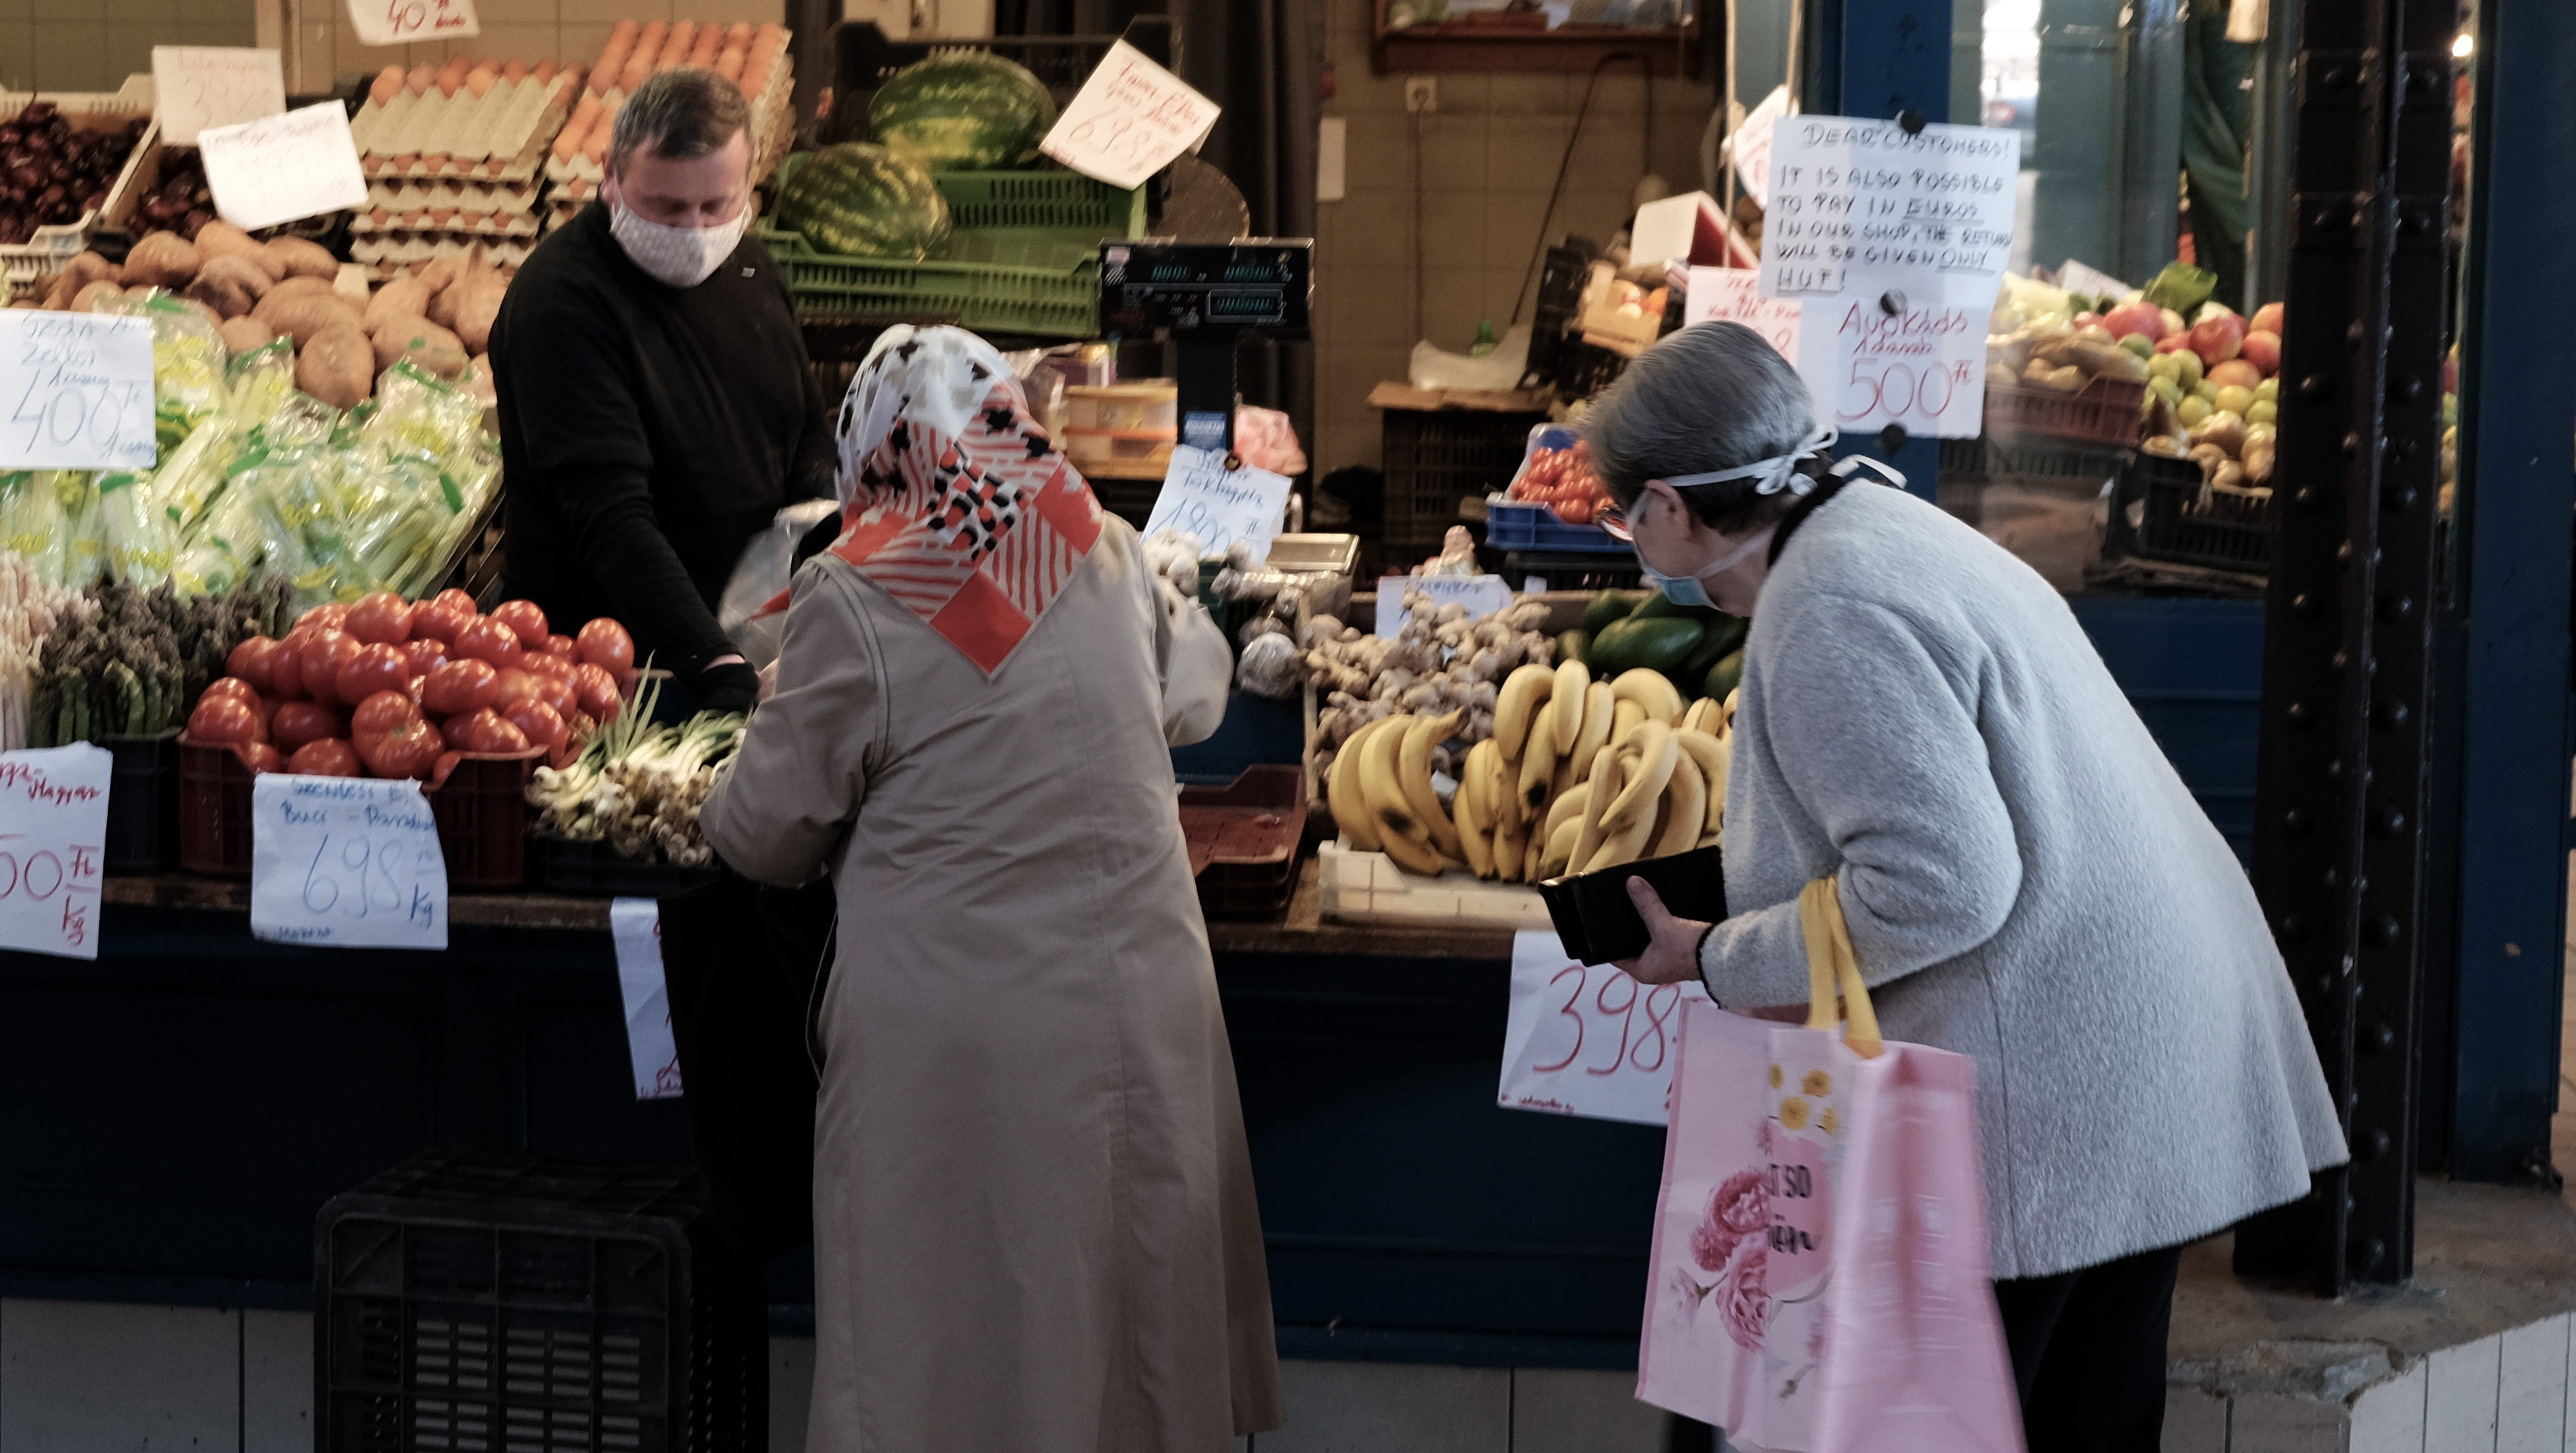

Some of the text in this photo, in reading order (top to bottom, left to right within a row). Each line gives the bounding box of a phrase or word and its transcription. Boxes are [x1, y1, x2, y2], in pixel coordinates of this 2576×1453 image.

[1801, 123, 2012, 161] DEAR CUSTOMERS!
[1778, 164, 2004, 195] IT IS ALSO POSSIBLE
[1776, 192, 1979, 220] TO PAY IN EUROS
[1777, 219, 1801, 238] IN
[1809, 223, 1856, 240] OUR
[1920, 227, 1954, 245] THE
[1775, 242, 1989, 268] WILL BE GIVEN ONLY
[1834, 357, 1953, 422] 500
[11, 368, 122, 456] 400
[28, 776, 102, 807] Magyar
[304, 832, 403, 919] 698
[1532, 963, 1682, 1077] 398
